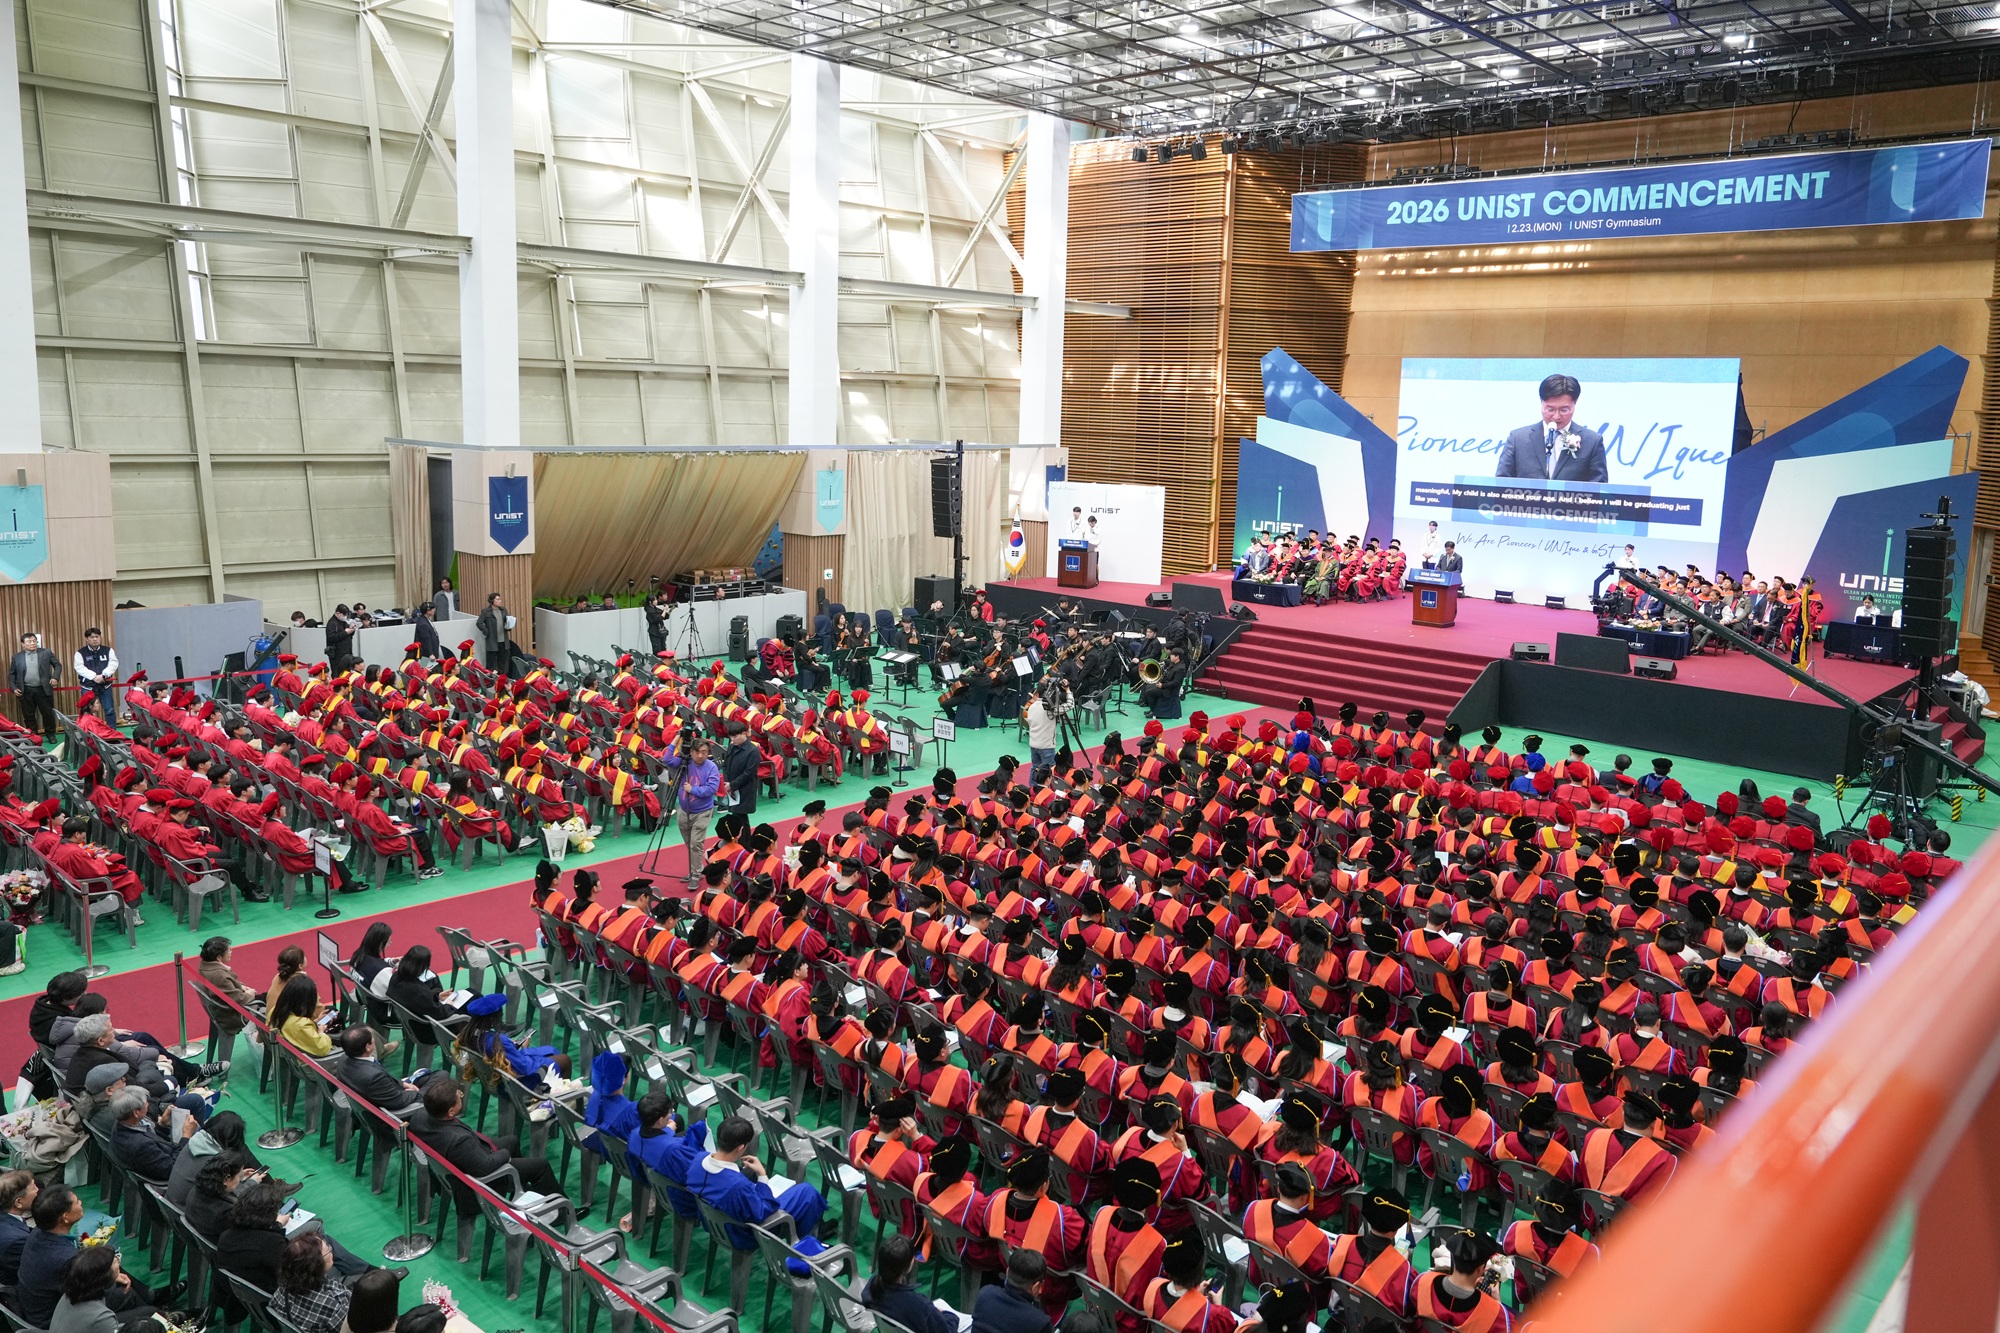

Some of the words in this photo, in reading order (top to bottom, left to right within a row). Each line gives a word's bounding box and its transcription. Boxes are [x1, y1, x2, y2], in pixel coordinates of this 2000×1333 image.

[1386, 201, 1450, 225] 2026
[1457, 192, 1536, 221] UNIST
[1543, 171, 1831, 216] COMMENCEMENT
[1511, 222, 1562, 234] 2.23.(MON)
[1574, 219, 1603, 230] UNIST
[1606, 216, 1661, 229] Gymnasium
[1397, 415, 1505, 455] Pioneer
[1463, 489, 1478, 497] child
[1634, 502, 1674, 511] graduating
[1675, 503, 1690, 511] just
[1478, 503, 1619, 525] COMMENCEMENT
[1456, 532, 1474, 545] We
[1474, 533, 1496, 549] Are
[1840, 572, 1904, 593] UNIS
